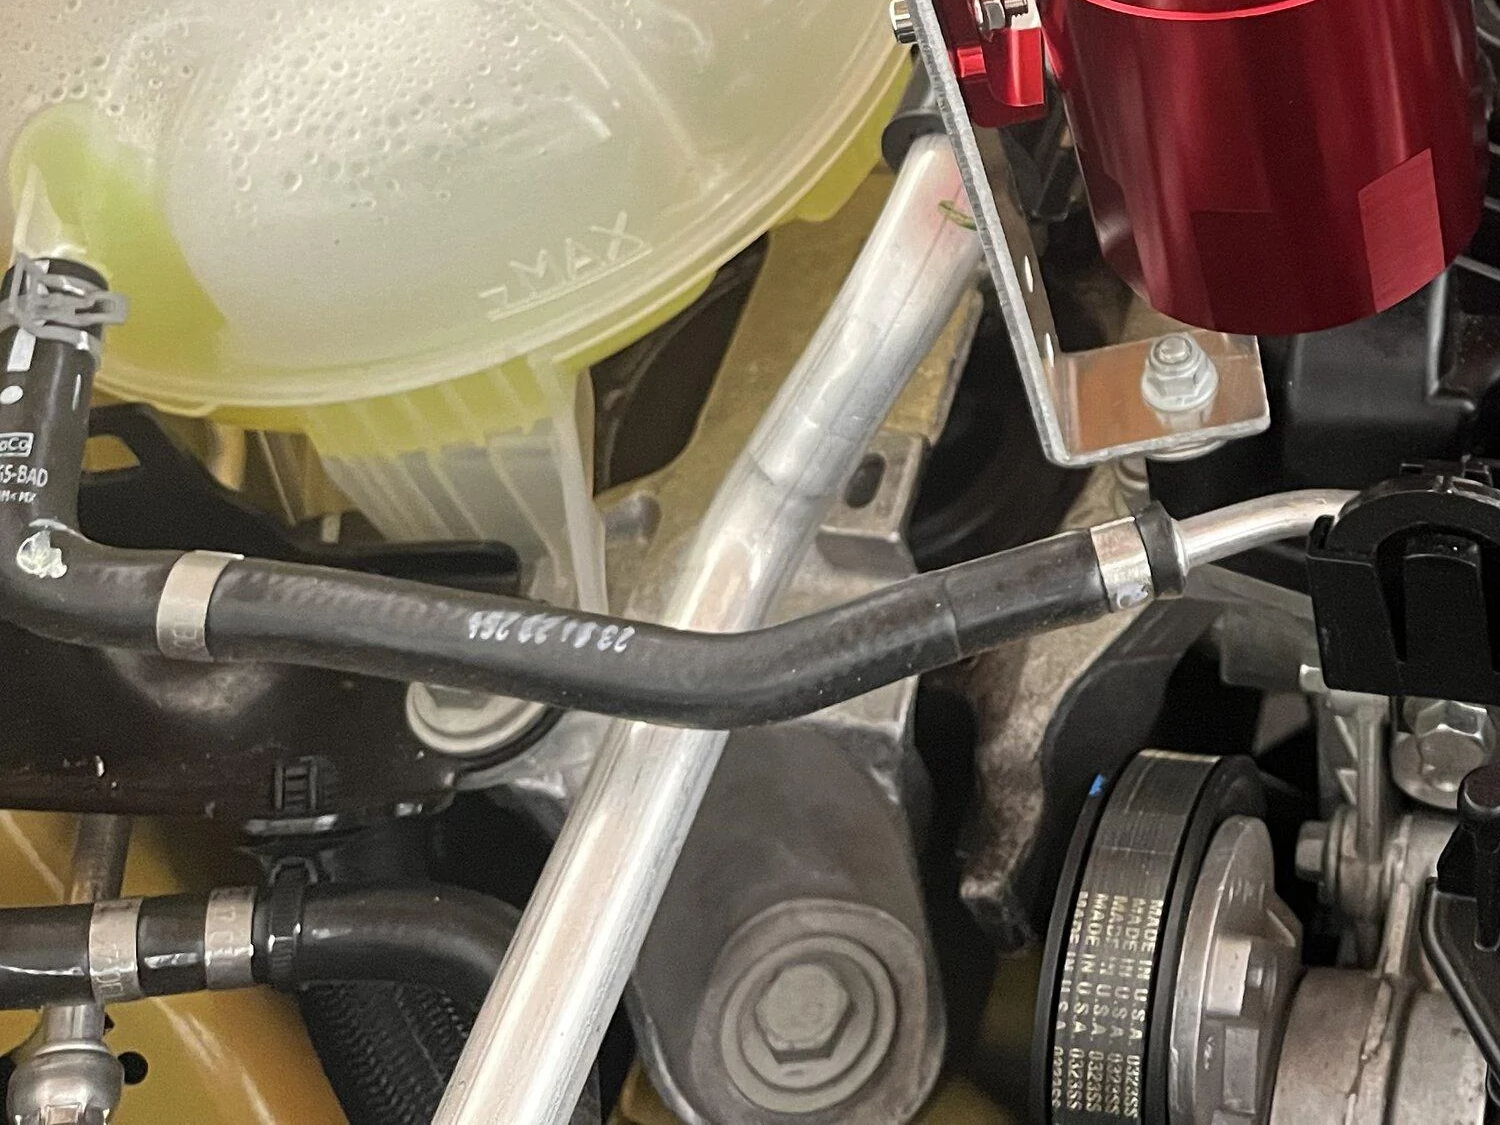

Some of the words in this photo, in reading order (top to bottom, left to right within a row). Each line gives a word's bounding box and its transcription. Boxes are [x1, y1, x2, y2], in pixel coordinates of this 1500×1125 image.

[510, 210, 646, 301] MAX
[1084, 893, 1109, 947] MADE
[1122, 898, 1146, 952] MADE
[1140, 899, 1164, 952] MADE
[1080, 953, 1097, 974] IN
[1136, 960, 1153, 980] IN
